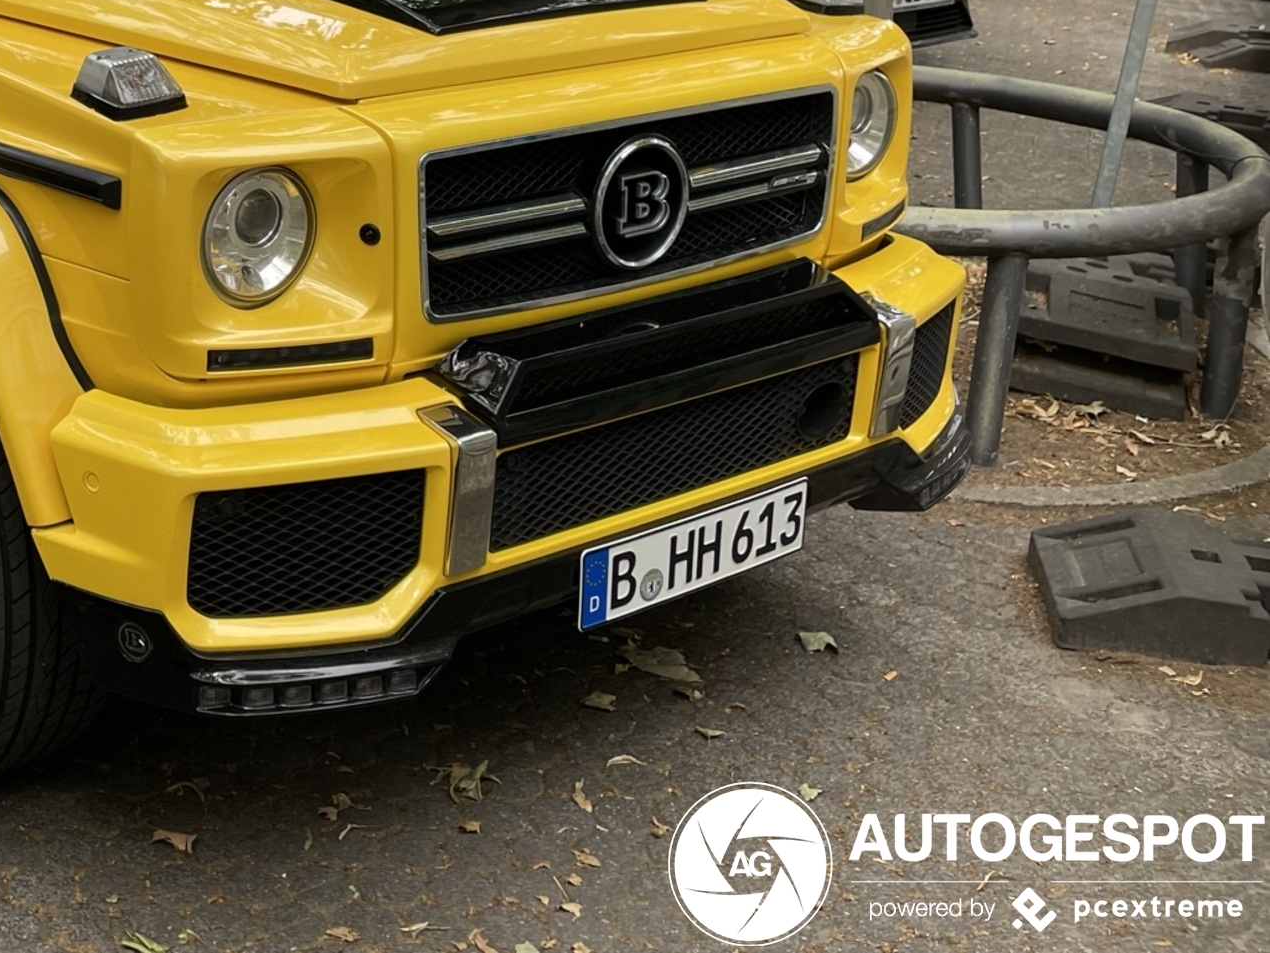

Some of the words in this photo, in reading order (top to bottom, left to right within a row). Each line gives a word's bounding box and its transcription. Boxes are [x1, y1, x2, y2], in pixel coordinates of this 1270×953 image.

[610, 551, 637, 610] B
[668, 520, 723, 590] HH
[732, 491, 804, 564] 613
[590, 596, 599, 613] D
